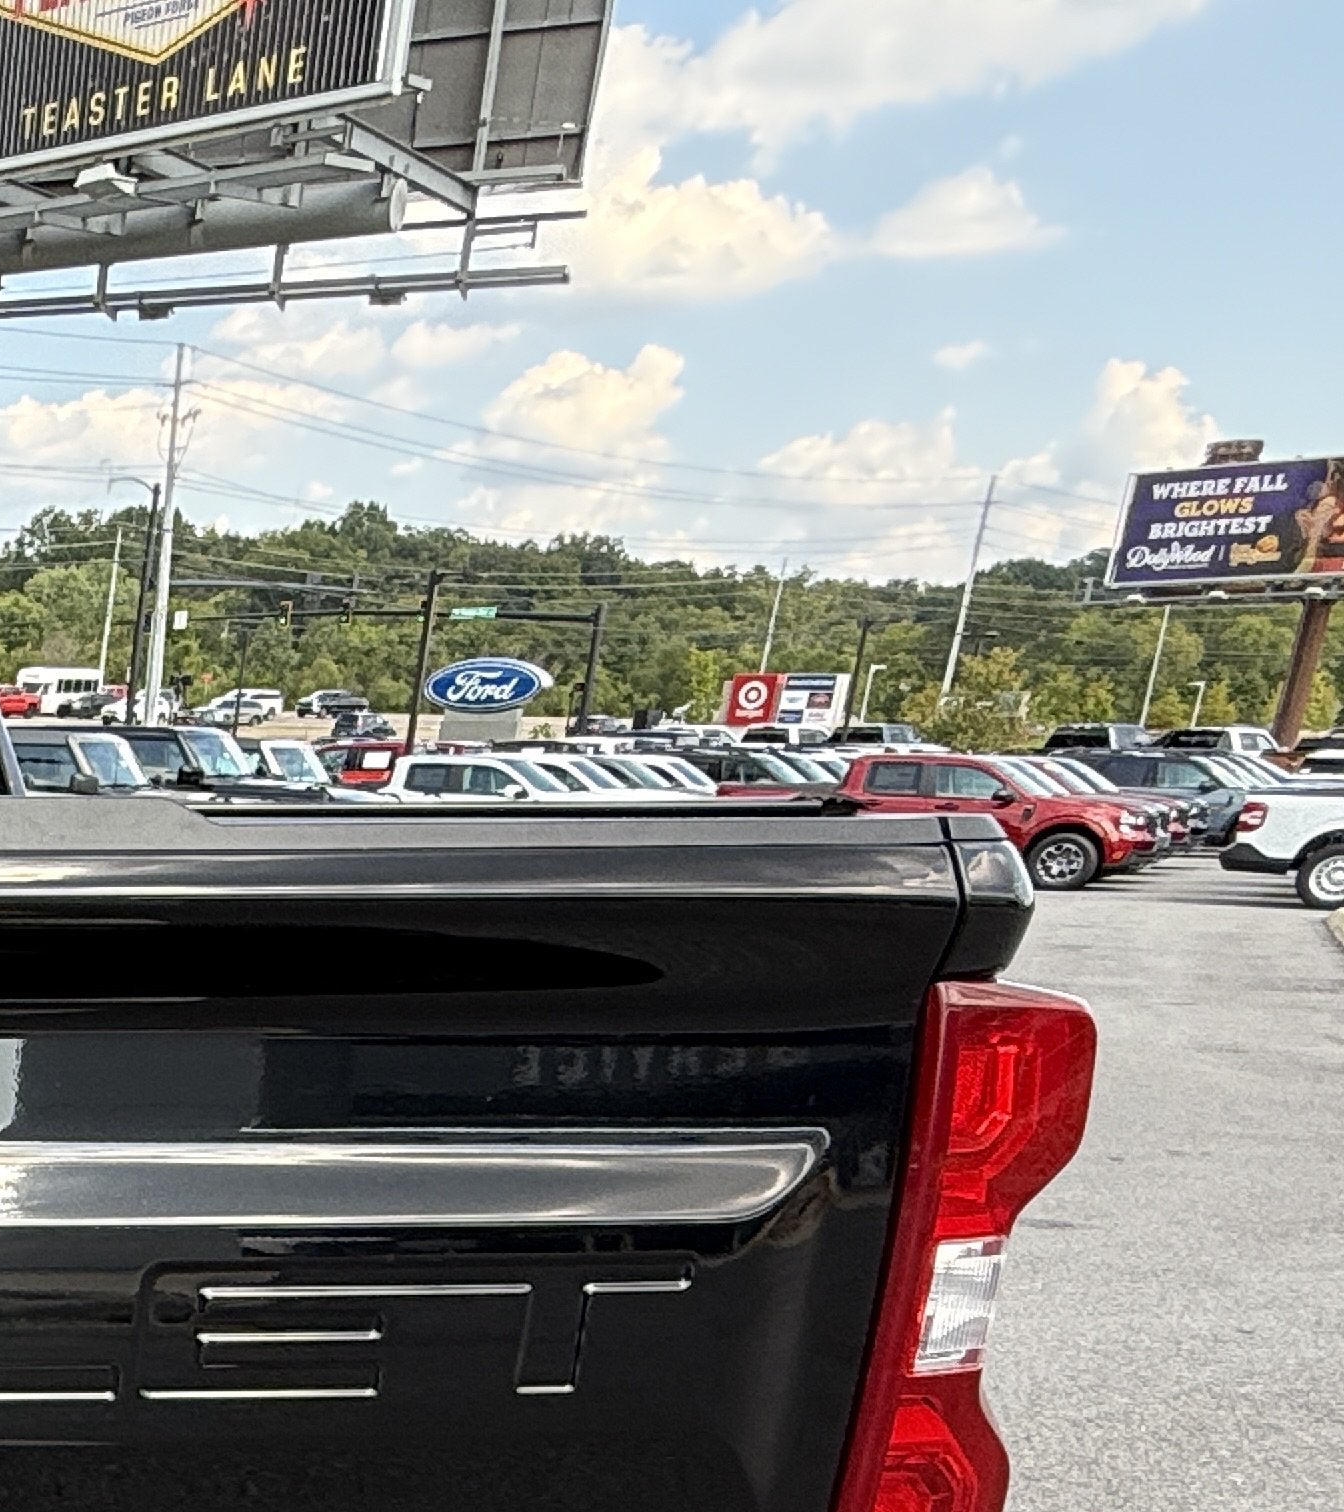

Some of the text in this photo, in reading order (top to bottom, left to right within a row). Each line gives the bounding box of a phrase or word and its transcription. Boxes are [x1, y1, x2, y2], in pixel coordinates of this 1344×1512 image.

[123, 5, 162, 25] PIGEON
[22, 45, 308, 140] TEASTER LANE
[1153, 473, 1288, 499] WHERE FALL
[1175, 497, 1254, 517] GLOWS
[1149, 515, 1273, 539] BRIGHTEST
[446, 670, 520, 702] Ford
